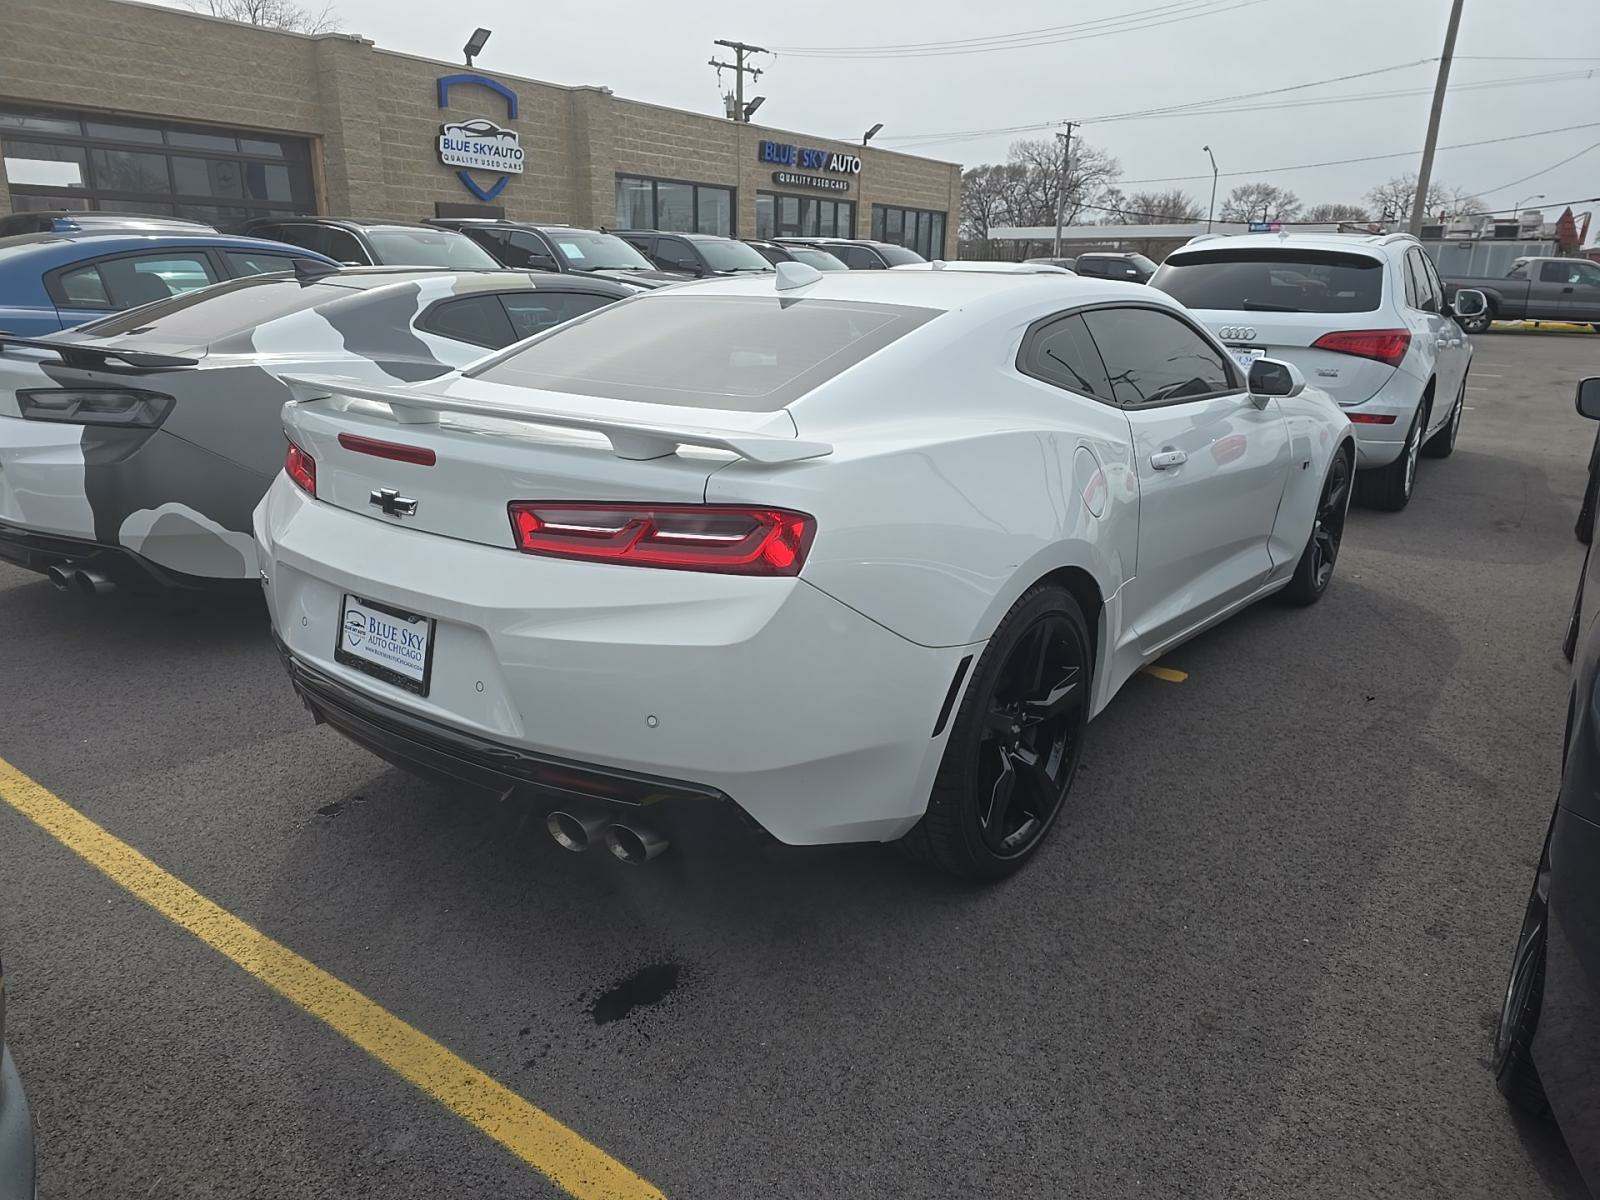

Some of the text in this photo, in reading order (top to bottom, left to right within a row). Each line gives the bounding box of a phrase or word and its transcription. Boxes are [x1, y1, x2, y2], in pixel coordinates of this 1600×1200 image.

[443, 138, 470, 152] BLUE
[443, 154, 522, 170] QUALITY USED CARS
[763, 141, 862, 174] BLUE SKY AUTO
[779, 172, 848, 190] QUALITY USED CARS
[369, 616, 398, 642] BLUE
[401, 628, 424, 651] SKY
[369, 635, 387, 649] AUTO
[388, 641, 422, 662] CHICAGO
